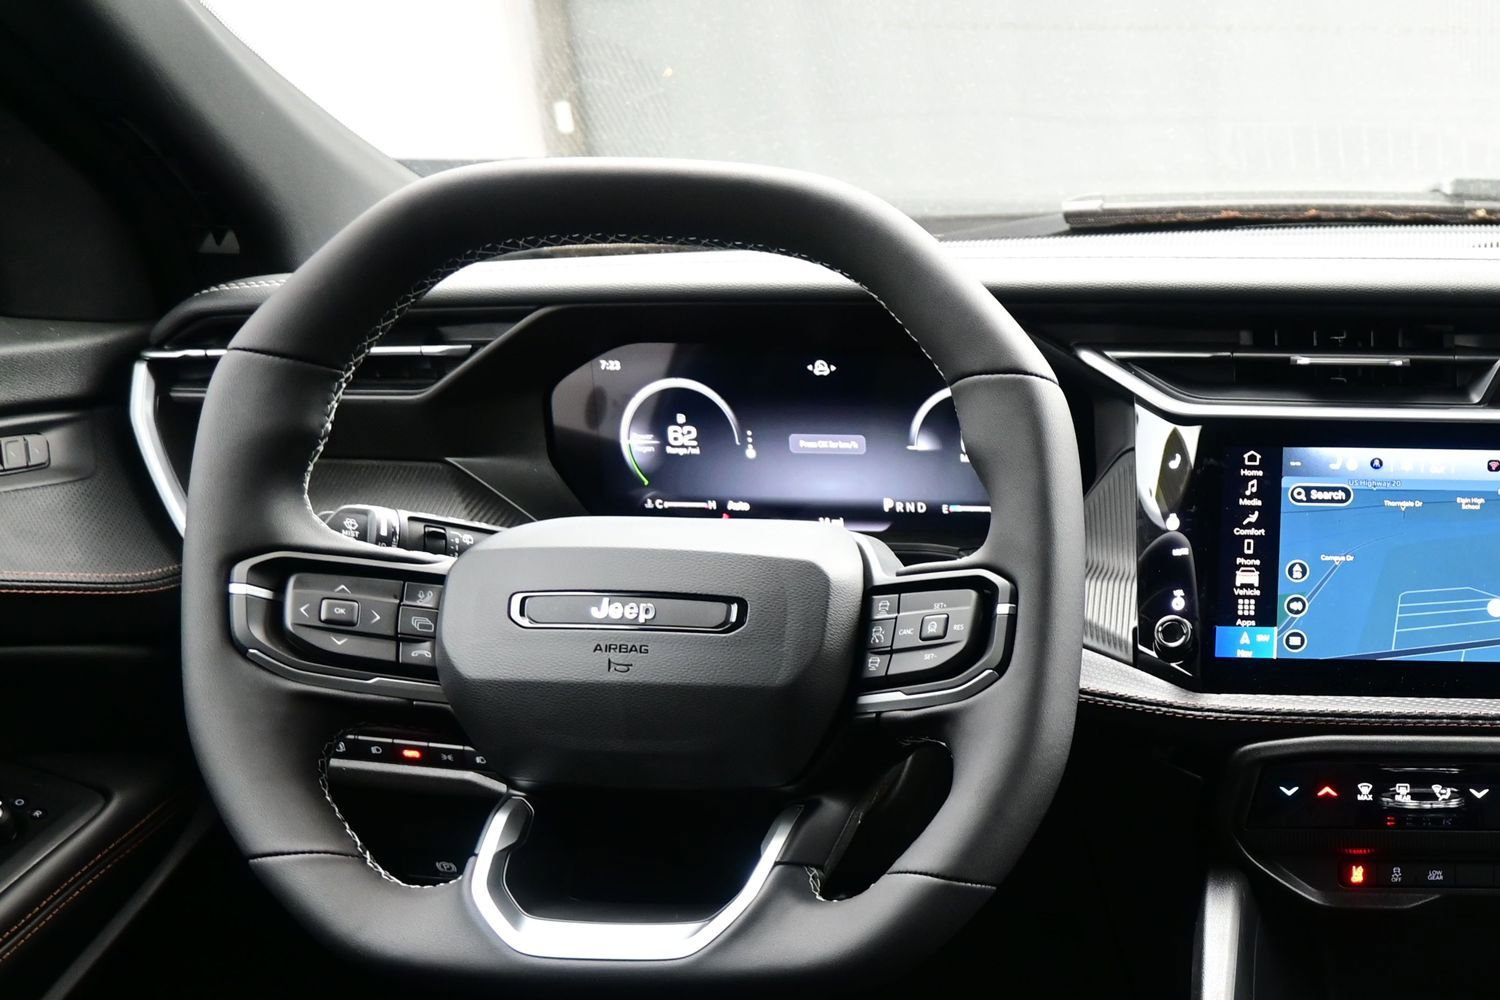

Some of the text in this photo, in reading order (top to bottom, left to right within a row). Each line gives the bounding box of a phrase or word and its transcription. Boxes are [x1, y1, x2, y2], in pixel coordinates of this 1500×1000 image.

[667, 425, 698, 446] 62
[1240, 468, 1264, 477] Home
[1360, 480, 1391, 489] Highway
[1310, 489, 1346, 500] Search
[1239, 498, 1262, 506] Media
[1233, 527, 1265, 536] Comfort
[1236, 557, 1261, 566] Phone
[1233, 588, 1260, 596] Vehicle
[334, 606, 347, 615] OK
[590, 597, 656, 623] Jeep
[1236, 619, 1256, 627] Apps
[593, 642, 650, 655] AIRBAG
